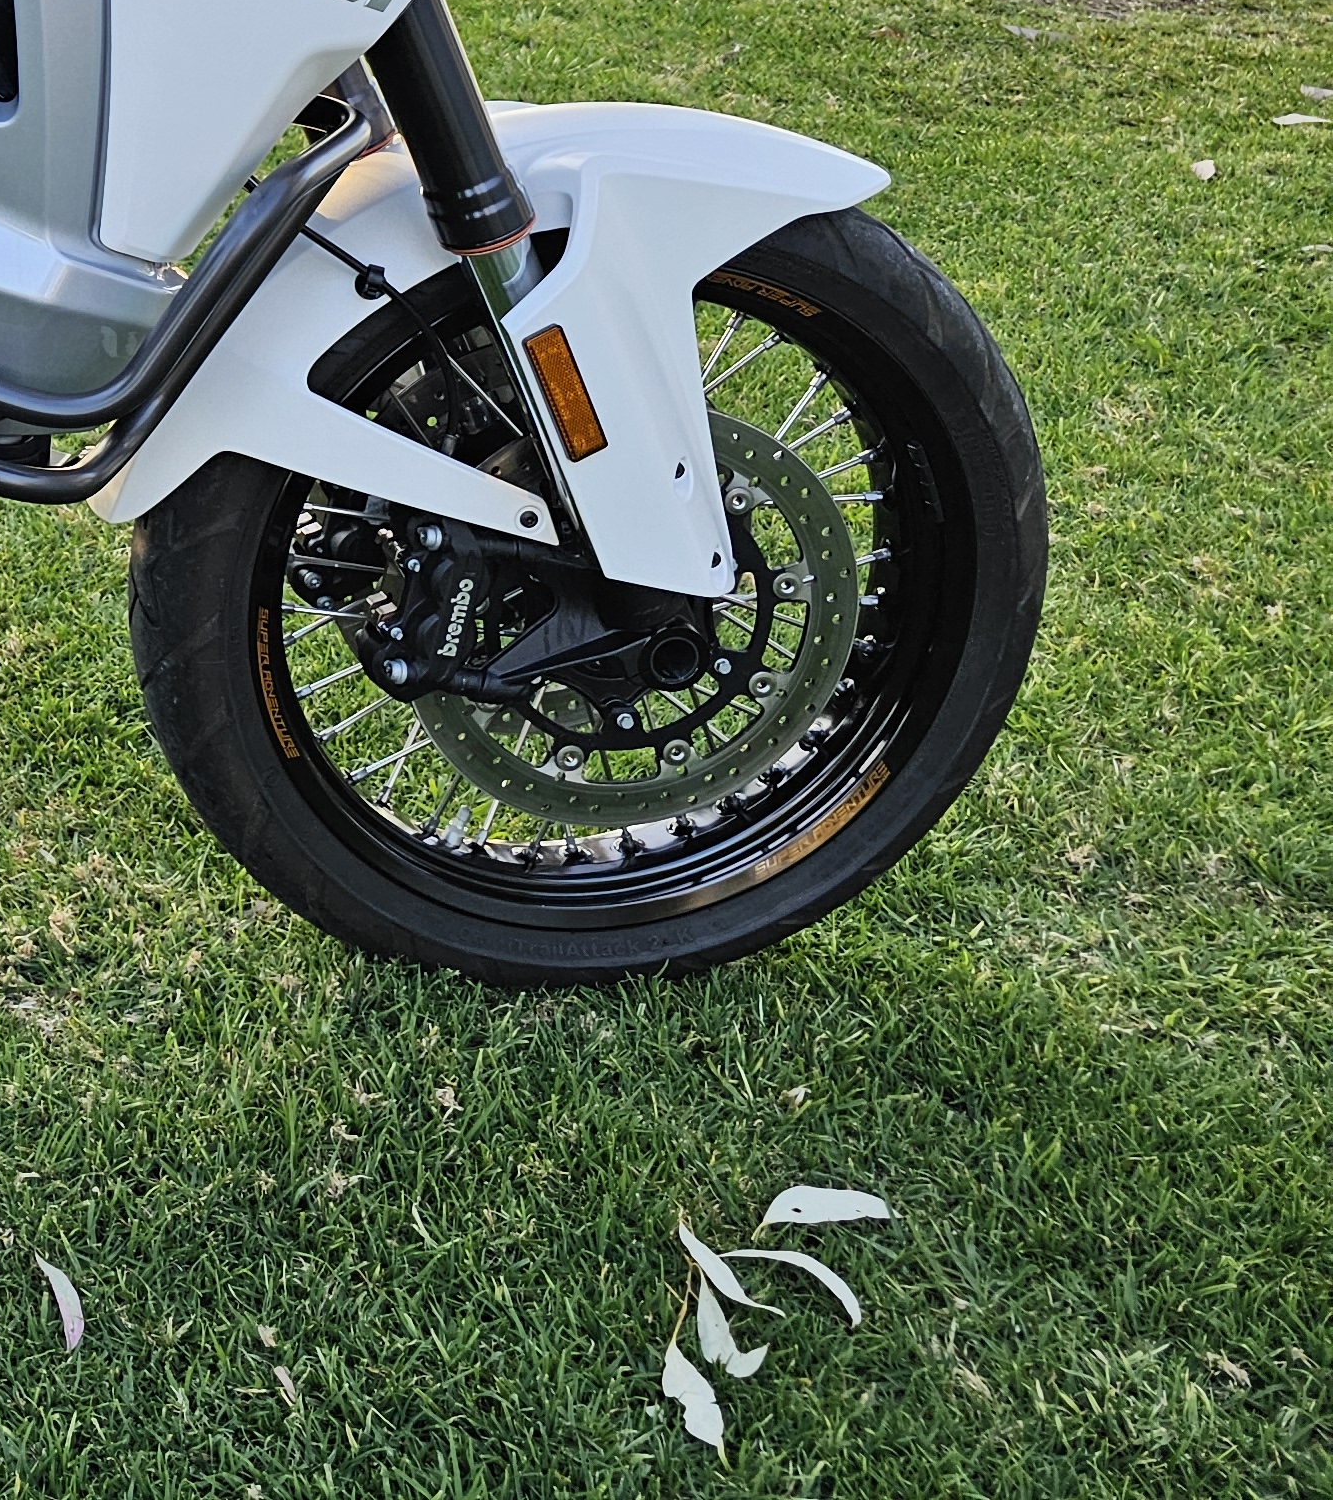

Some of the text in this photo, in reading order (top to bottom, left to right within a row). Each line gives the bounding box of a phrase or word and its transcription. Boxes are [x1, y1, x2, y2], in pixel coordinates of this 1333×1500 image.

[436, 578, 474, 657] brembo
[259, 607, 300, 759] SUPER ADVENTURE
[812, 760, 891, 840] ADVENTURE
